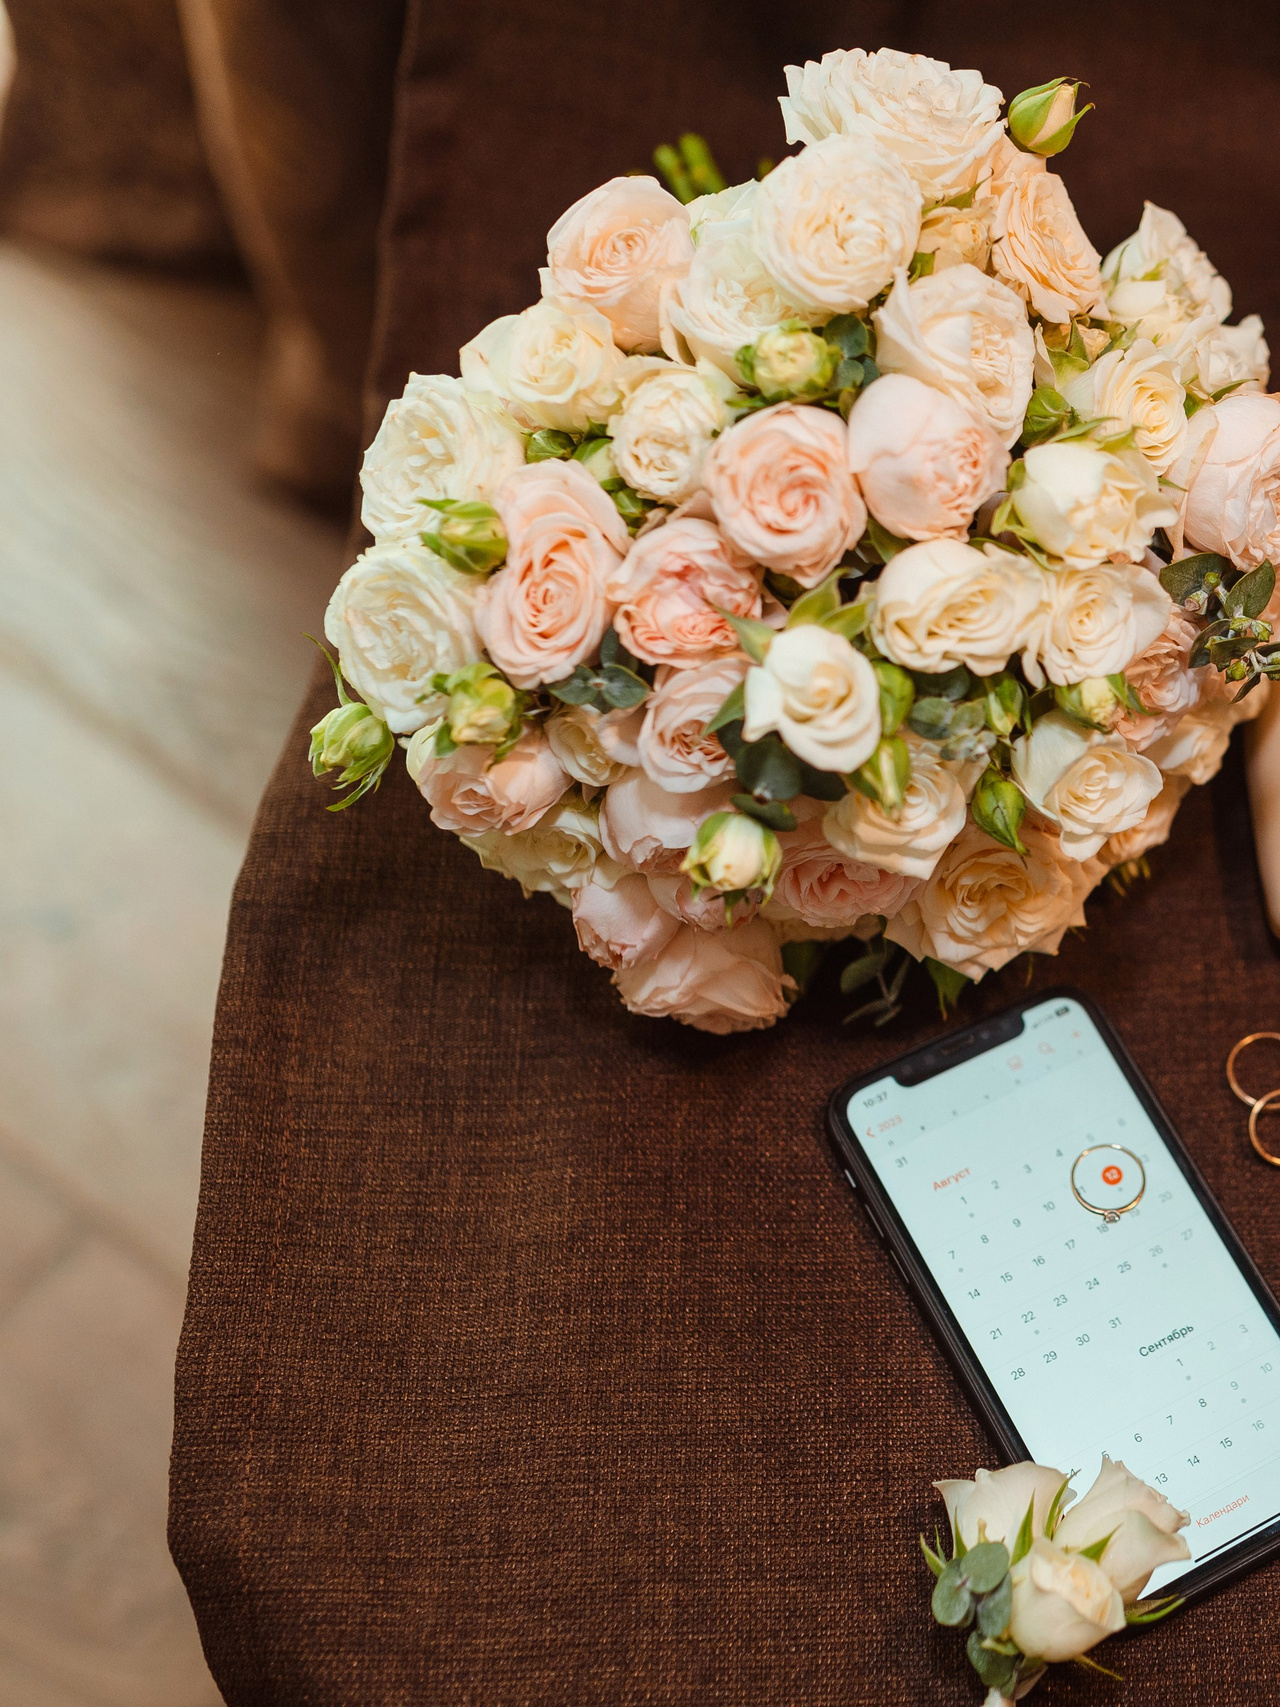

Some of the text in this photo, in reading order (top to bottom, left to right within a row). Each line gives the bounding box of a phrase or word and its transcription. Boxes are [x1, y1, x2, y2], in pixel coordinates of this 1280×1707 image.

[895, 1156, 908, 1168] 31
[932, 1167, 971, 1191] Август
[960, 1196, 968, 1205] 1
[948, 1250, 956, 1260] 7
[980, 1234, 989, 1244] 8
[1012, 1218, 1021, 1228] 9
[1043, 1201, 1056, 1212] 10
[967, 1288, 981, 1300] 14
[1000, 1272, 1013, 1283] 15
[1032, 1256, 1046, 1267] 16
[1064, 1239, 1076, 1250] 17
[1095, 1223, 1109, 1234] 18
[989, 1328, 1003, 1340] 21
[1021, 1311, 1036, 1323] 22
[1053, 1294, 1068, 1307] 23
[1085, 1278, 1100, 1290] 24
[1117, 1261, 1132, 1273] 25
[1149, 1244, 1164, 1257] 26
[1010, 1317, 1122, 1381] 28 29 30 31
[1138, 1325, 1195, 1357] Сентябрь
[1175, 1324, 1249, 1367] 1 2 3
[1133, 1433, 1143, 1443] 6
[1165, 1415, 1174, 1425] 7
[1198, 1398, 1208, 1408] 8
[1229, 1381, 1239, 1391] 9
[1260, 1362, 1273, 1374] 10
[1154, 1473, 1168, 1485] 13
[1186, 1455, 1200, 1467] 14
[1219, 1437, 1233, 1449] 15
[1251, 1419, 1265, 1432] 16
[1195, 1494, 1250, 1528] Календари
